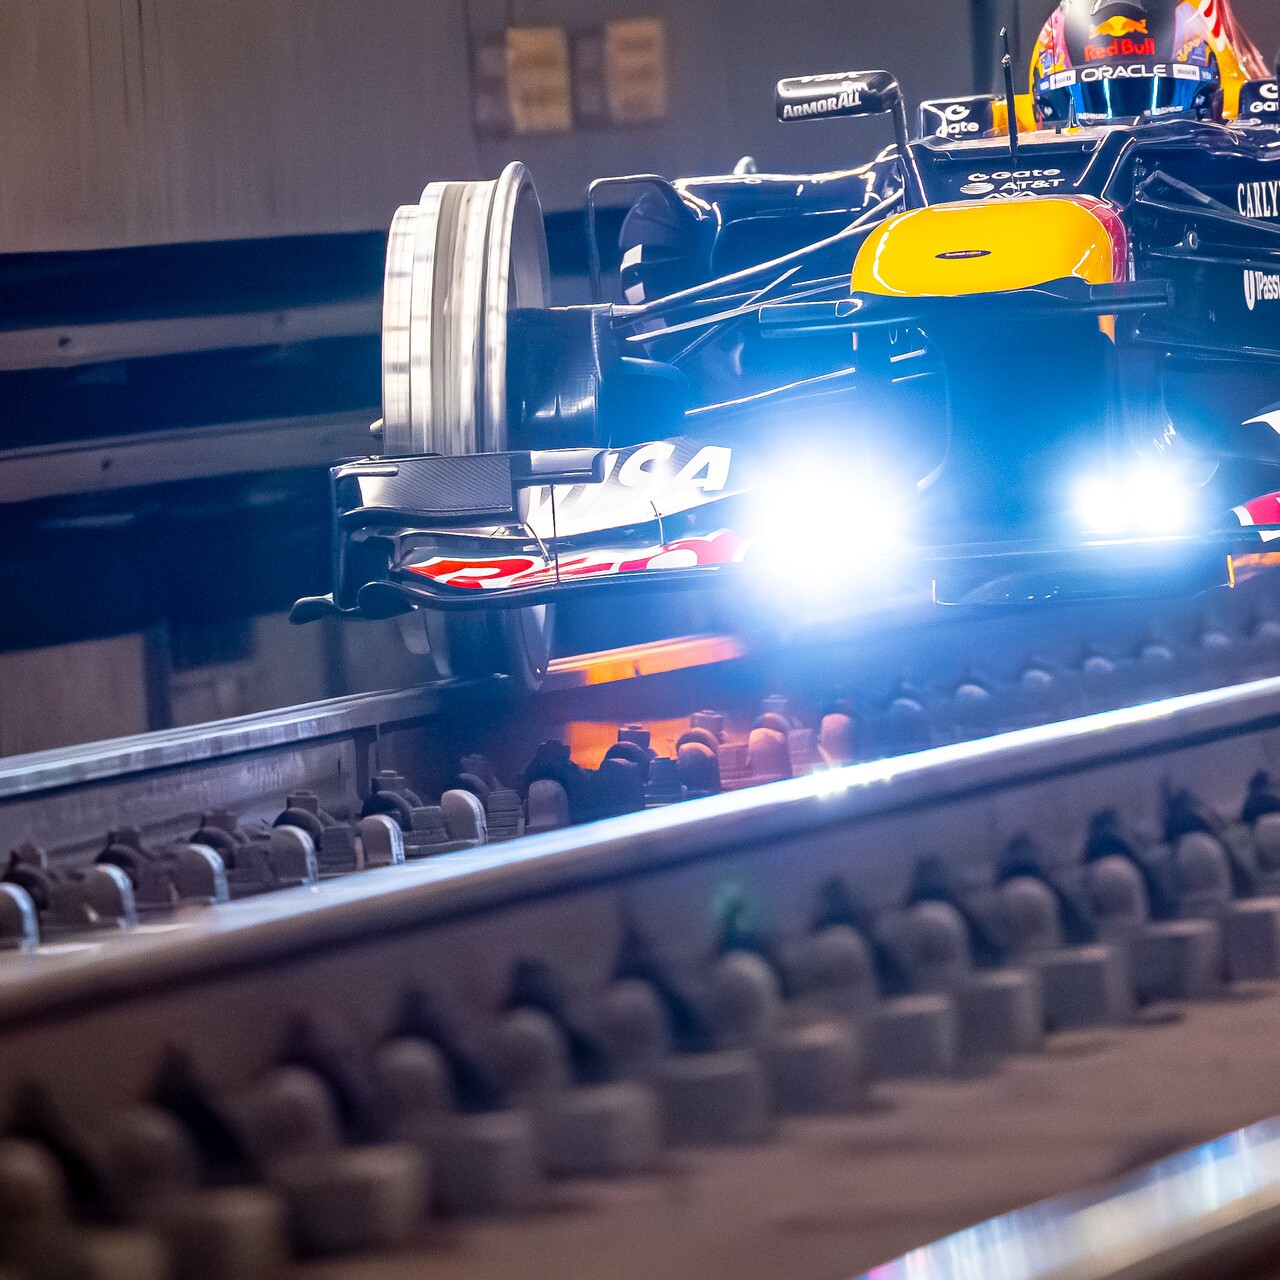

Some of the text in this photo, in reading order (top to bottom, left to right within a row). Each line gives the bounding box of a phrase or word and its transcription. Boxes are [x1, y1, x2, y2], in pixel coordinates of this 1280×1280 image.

[1084, 38, 1155, 61] Red Bull
[1081, 64, 1167, 81] ORACLE
[999, 178, 1066, 191] AT&T
